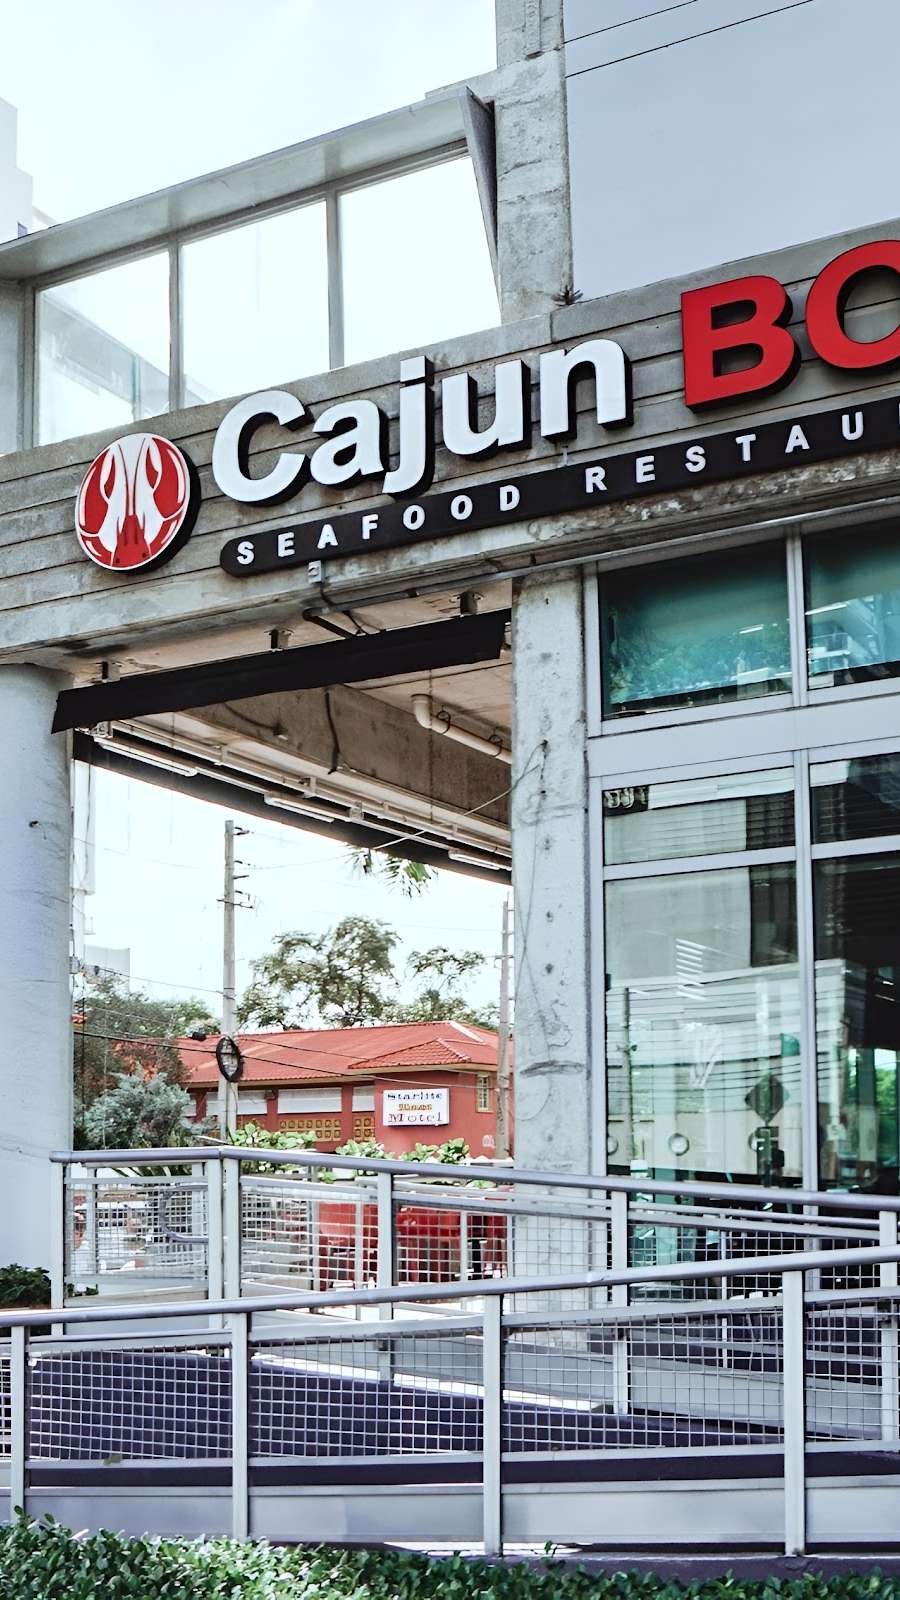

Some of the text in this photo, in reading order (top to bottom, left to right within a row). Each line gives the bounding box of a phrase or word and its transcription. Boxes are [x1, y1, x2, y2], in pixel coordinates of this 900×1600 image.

[212, 239, 900, 504] Cajun BO
[236, 402, 900, 565] SEAFOOD RESTAU
[387, 1111, 443, 1123] Motel
